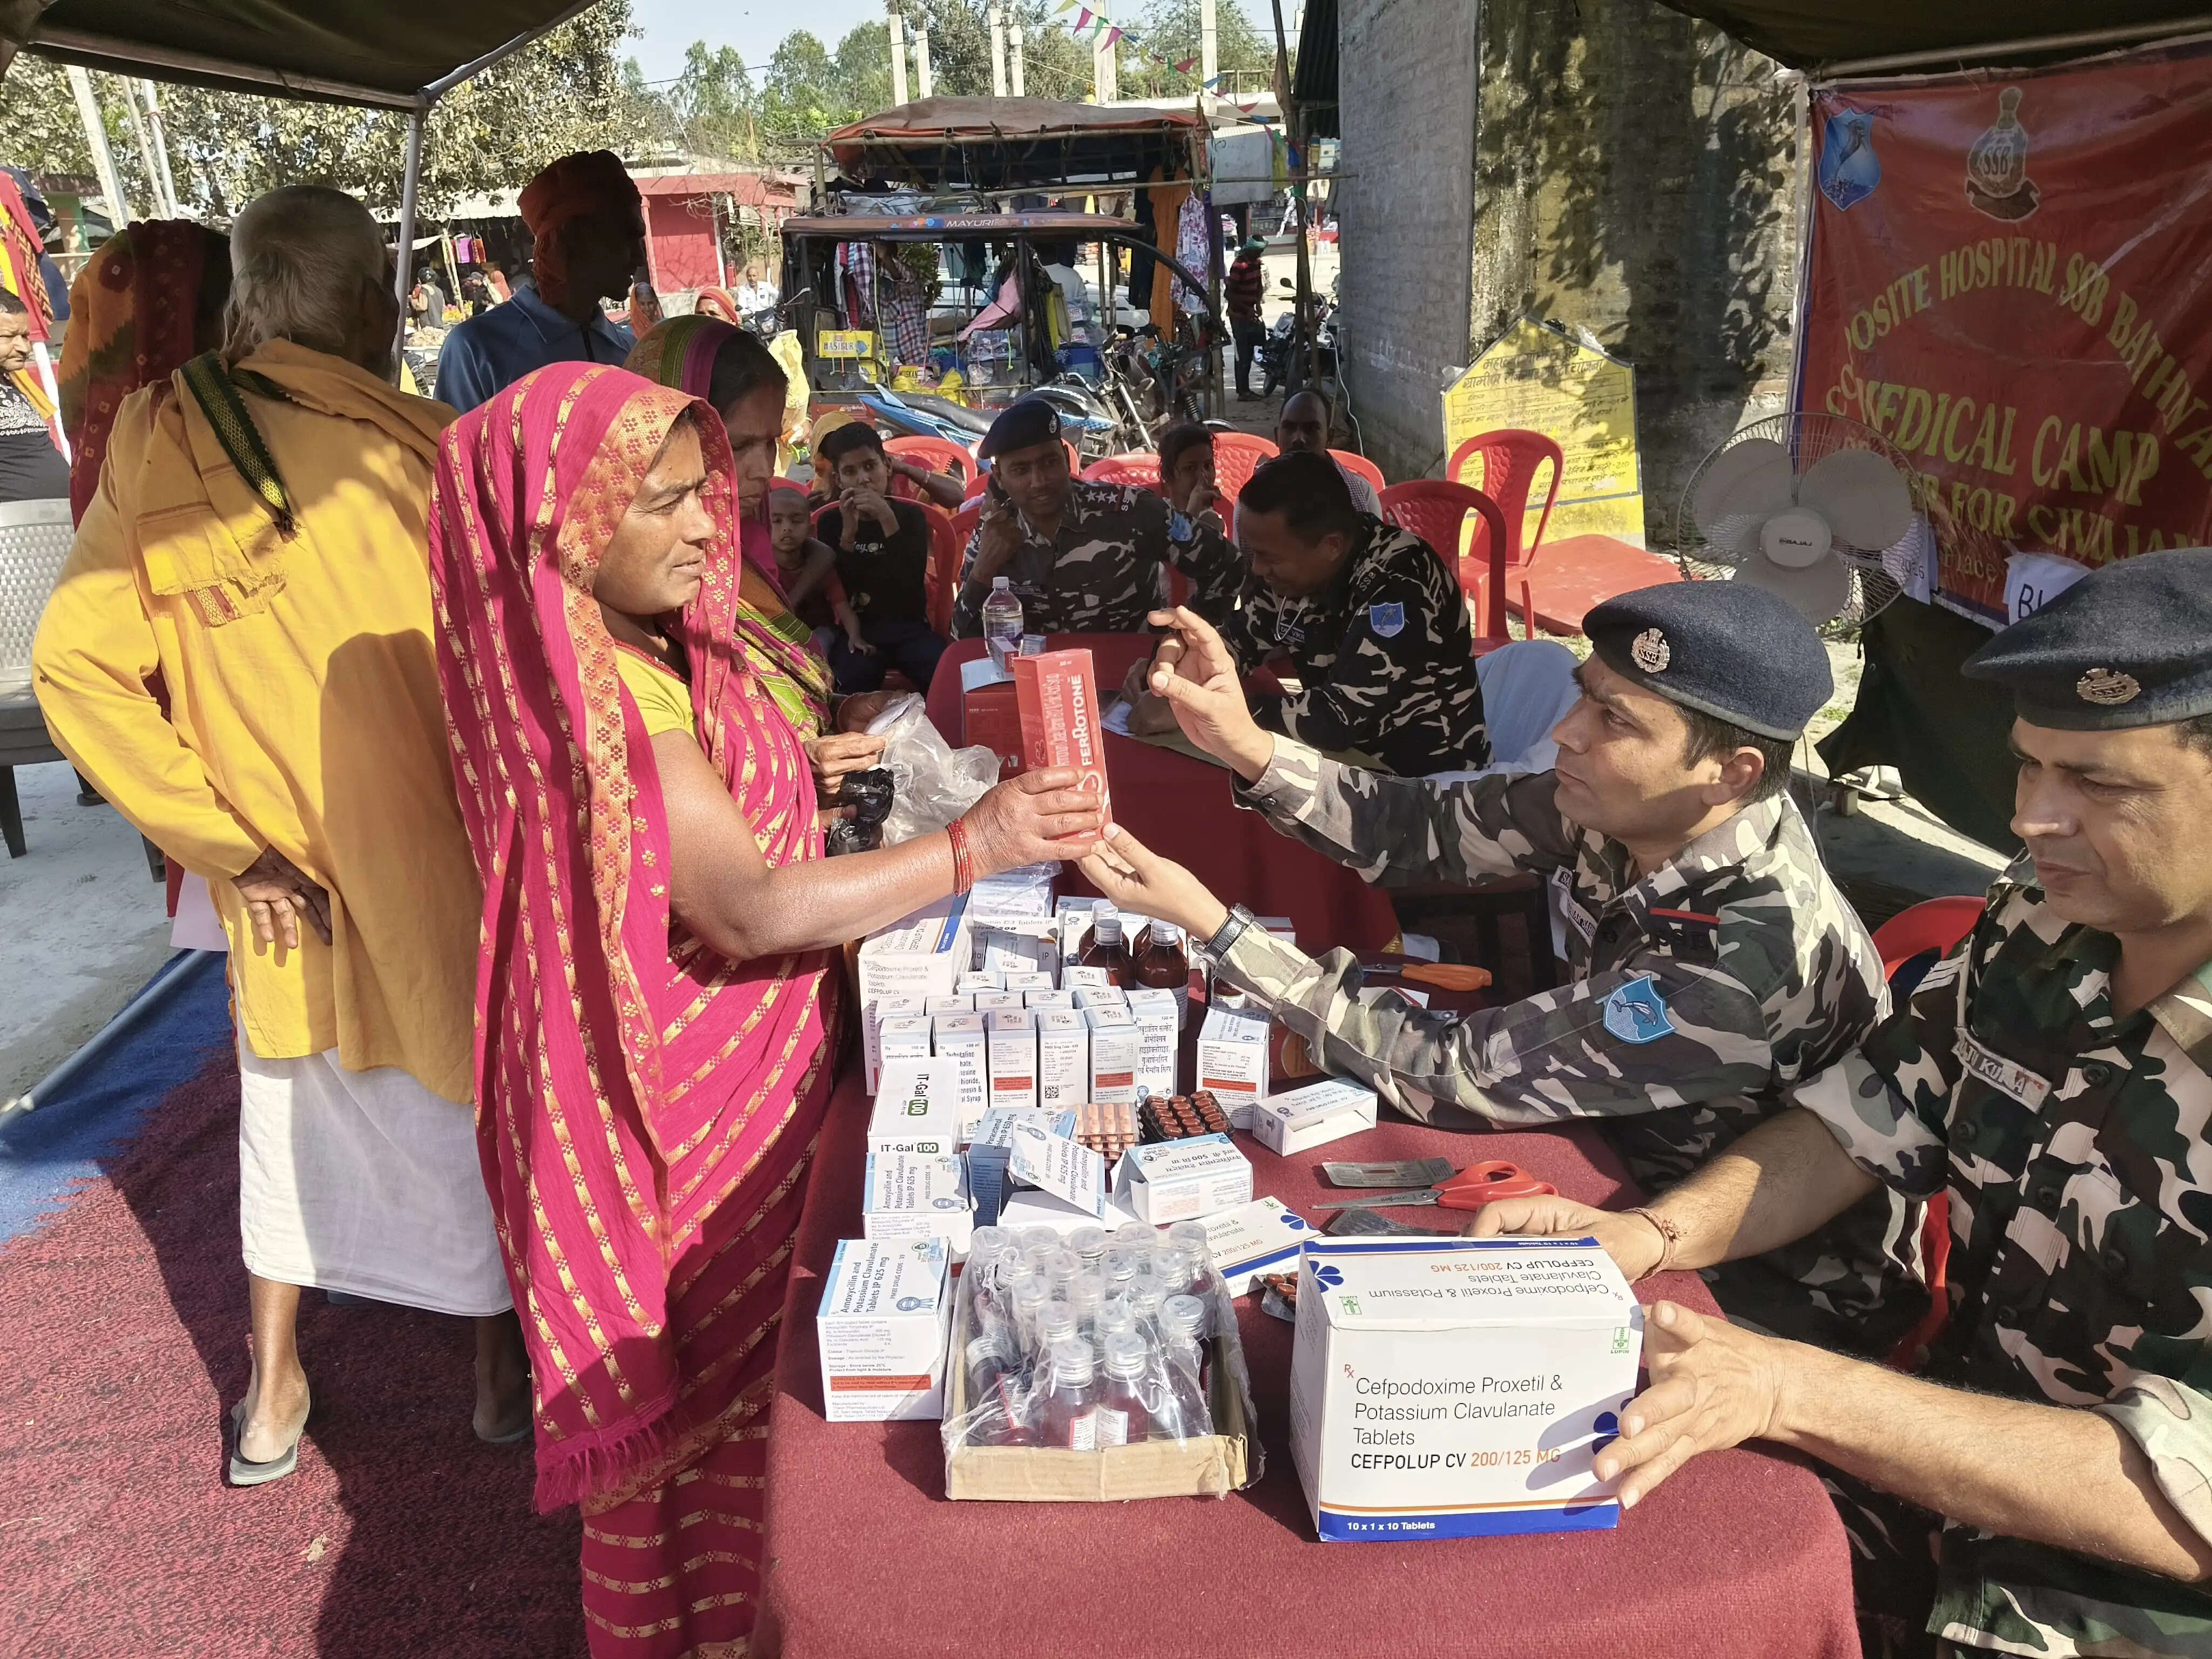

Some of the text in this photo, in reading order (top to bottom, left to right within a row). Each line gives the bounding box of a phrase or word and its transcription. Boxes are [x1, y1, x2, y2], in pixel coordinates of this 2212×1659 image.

[1984, 145, 2009, 176] SSB
[946, 219, 995, 227] MAYURI
[1826, 237, 2212, 480] COOSITE HOSPITAL SSB BATHNA
[2032, 415, 2159, 507] CAMP
[1952, 481, 2016, 539] FOR
[1070, 675, 1094, 767] FERROTONE
[1042, 952, 1050, 961] IP
[967, 1095, 981, 1103] Syrup
[911, 1100, 928, 1115] 100
[986, 1118, 1003, 1145] Paracetamol
[917, 1143, 938, 1152] 100
[994, 1134, 1007, 1150] Tablets
[1061, 1141, 1069, 1157] Tablets
[909, 1166, 918, 1175] mg
[1069, 1144, 1079, 1202] Potassium Clavulanate
[894, 1155, 905, 1209] Potassium Clavulanate
[907, 1176, 915, 1185] 625
[1058, 1175, 1067, 1184] mg
[1081, 1178, 1089, 1191] and
[883, 1170, 893, 1209] Amoxycillin and
[906, 1192, 915, 1209] Tablets
[1206, 1226, 1245, 1241] avulanate
[1208, 1220, 1232, 1233] roxetil
[1222, 1243, 1251, 1255] 200/125
[895, 1263, 904, 1274] CODE
[1430, 1259, 1595, 1272] CEFPOLUP CV 200/125 MG
[853, 1242, 879, 1313] Potassium Clavulanate
[866, 1290, 881, 1313] Tablets
[874, 1269, 885, 1280] 625
[880, 1257, 889, 1267] mg
[893, 1275, 901, 1287] DRUG
[1469, 1270, 1602, 1284] Clavulanate Tablets
[840, 1276, 858, 1313] Amoxycillin
[852, 1262, 862, 1274] and
[1369, 1283, 1609, 1300] Cefpodoxime Proxetil & Potassium
[1355, 1374, 1563, 1399] Cefpodoxime Proxetil &
[1354, 1401, 1556, 1421] Potassium Clavulanate
[1353, 1427, 1415, 1446] Tablets
[1351, 1448, 1561, 1471] CEFPOLUP CV 200/125 MG
[1347, 1520, 1436, 1532] 10 x 1 x 10 Tablets
